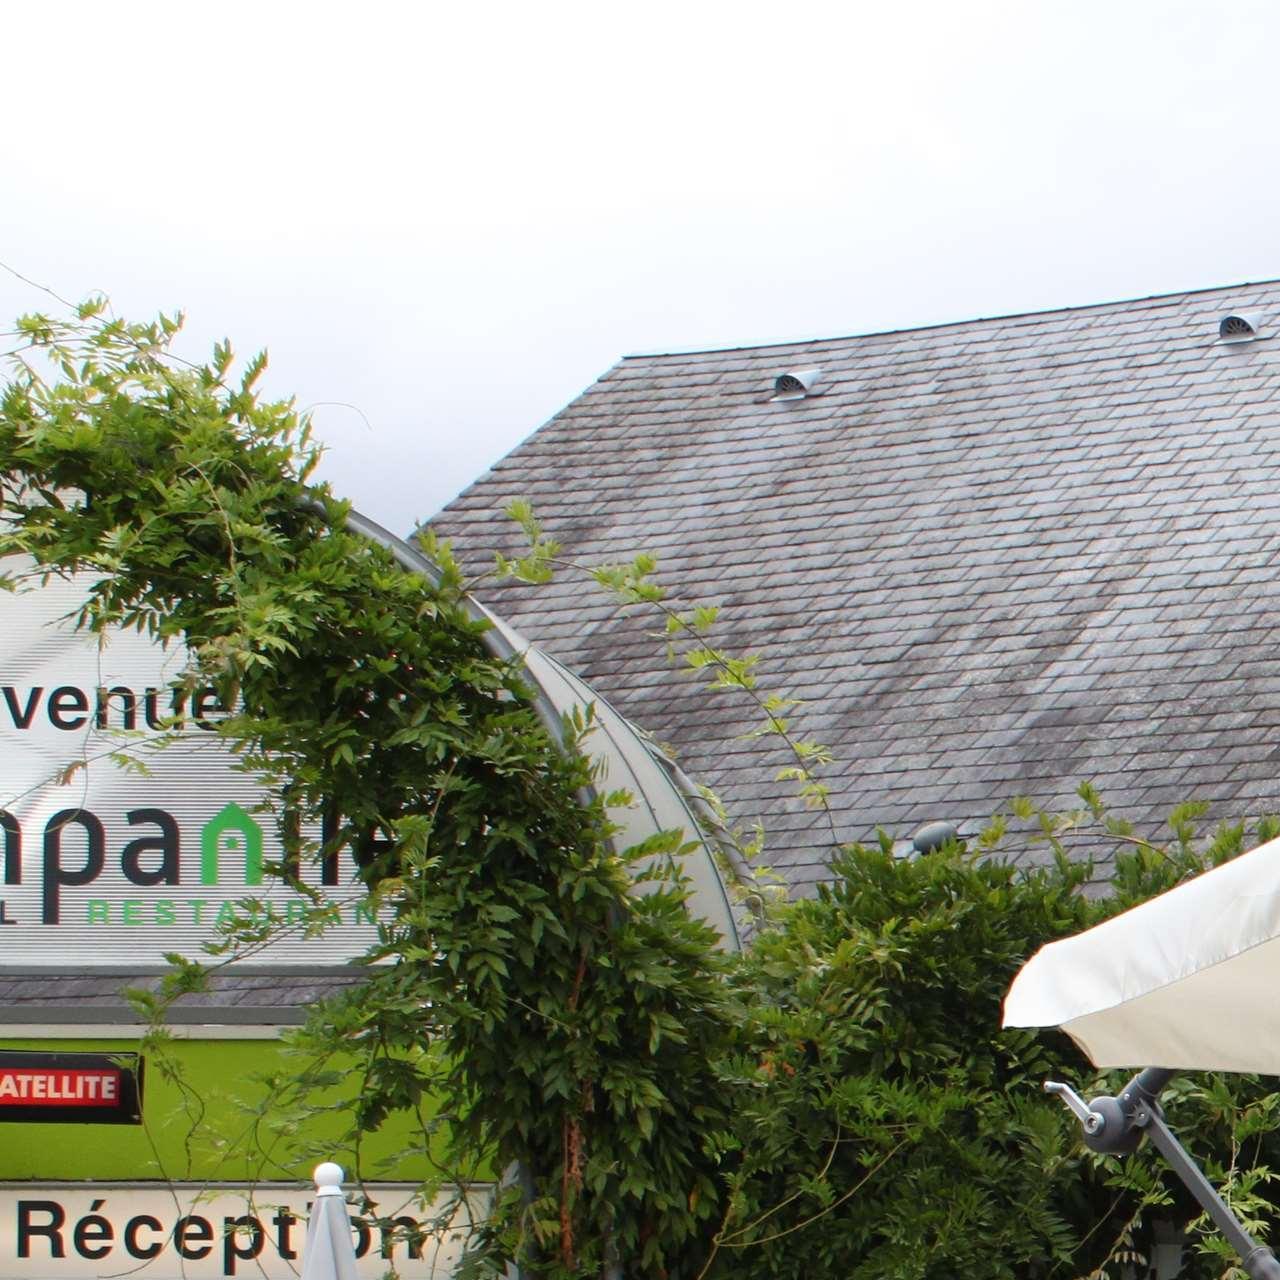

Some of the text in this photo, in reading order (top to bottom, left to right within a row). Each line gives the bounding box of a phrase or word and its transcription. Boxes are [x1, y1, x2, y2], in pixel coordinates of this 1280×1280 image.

[1, 685, 234, 732] venue
[86, 899, 384, 927] RESTAURAN
[0, 1074, 116, 1099] ATELLITE
[16, 1199, 424, 1276] Réceptn
